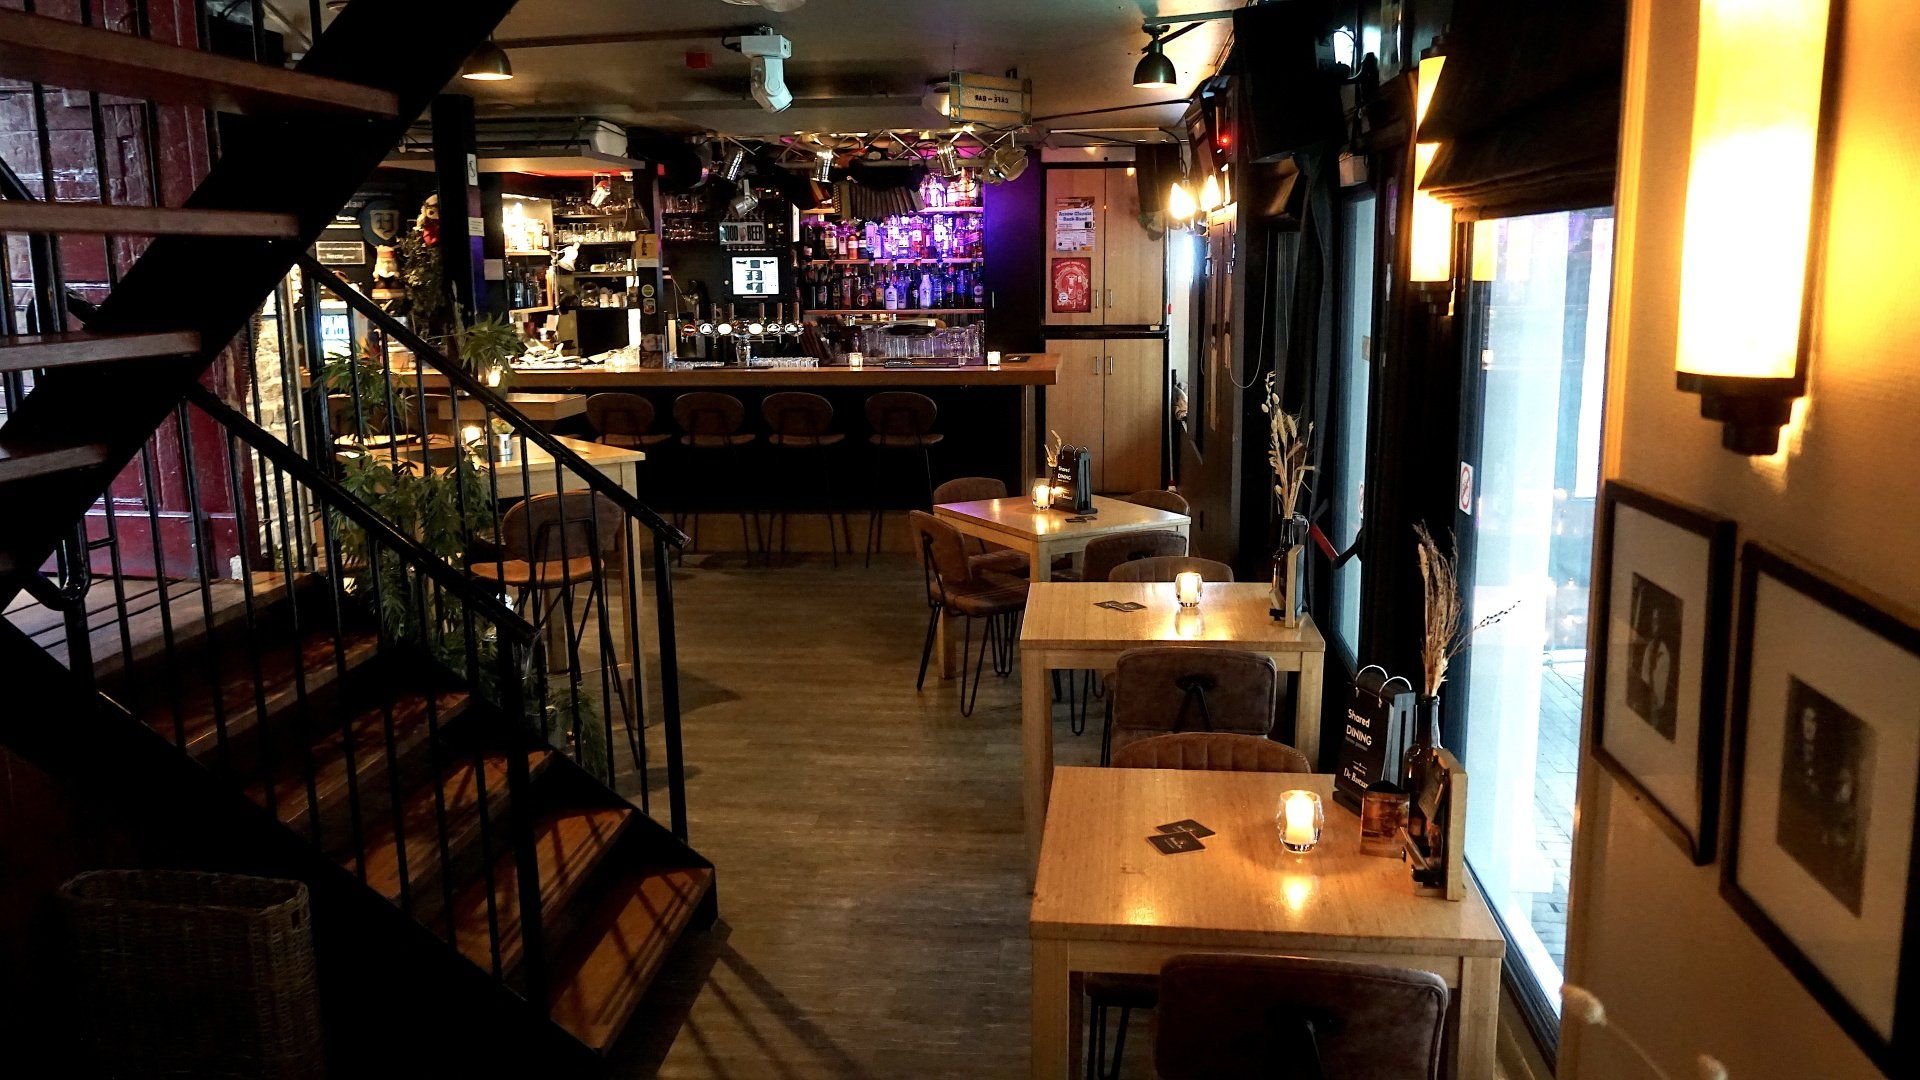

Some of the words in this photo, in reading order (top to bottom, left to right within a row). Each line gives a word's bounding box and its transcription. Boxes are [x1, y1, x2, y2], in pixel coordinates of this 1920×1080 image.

[720, 225, 739, 241] OOD
[747, 225, 764, 241] BEER
[1347, 708, 1371, 728] Shared
[1346, 724, 1373, 746] DINING
[1343, 767, 1351, 780] De
